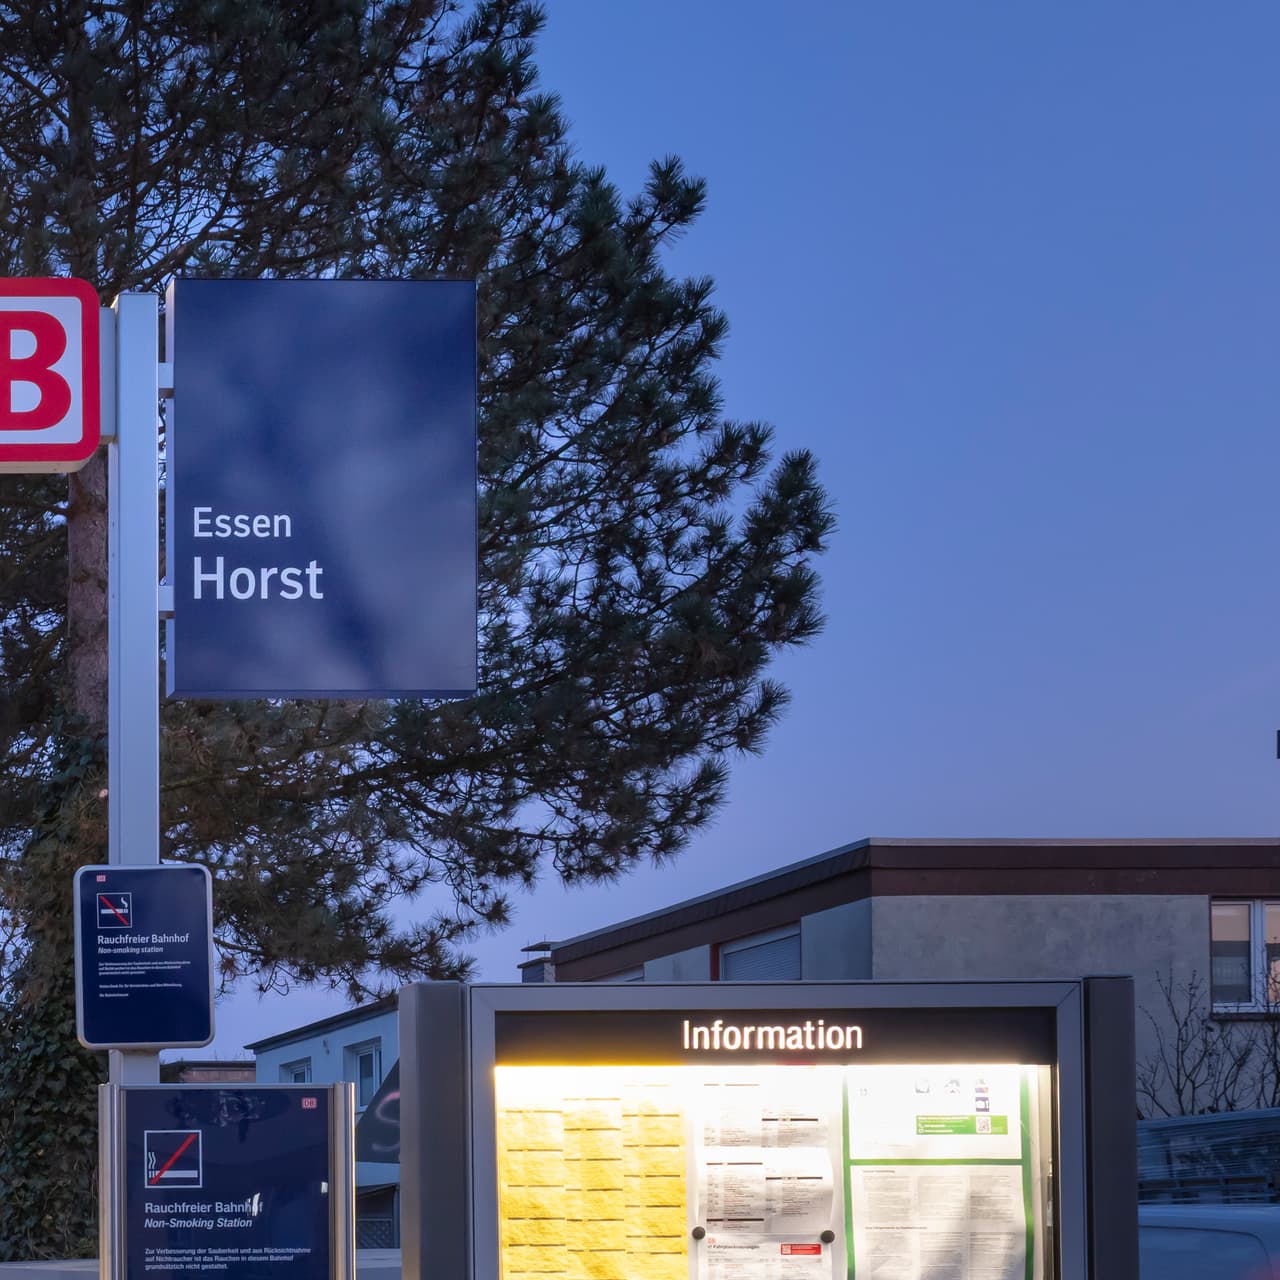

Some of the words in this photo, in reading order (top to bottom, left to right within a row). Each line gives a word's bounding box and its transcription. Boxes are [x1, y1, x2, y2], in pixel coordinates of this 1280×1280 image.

[194, 507, 291, 538] Essen
[194, 556, 324, 600] Horst
[97, 934, 149, 944] Rauchfreier
[151, 933, 190, 943] Bahnhof
[683, 1019, 863, 1050] Information
[145, 1202, 212, 1213] Rauchfreier
[215, 1201, 263, 1213] Bahnhf
[144, 1218, 214, 1229] Non-Smoking
[216, 1217, 252, 1228] Station
